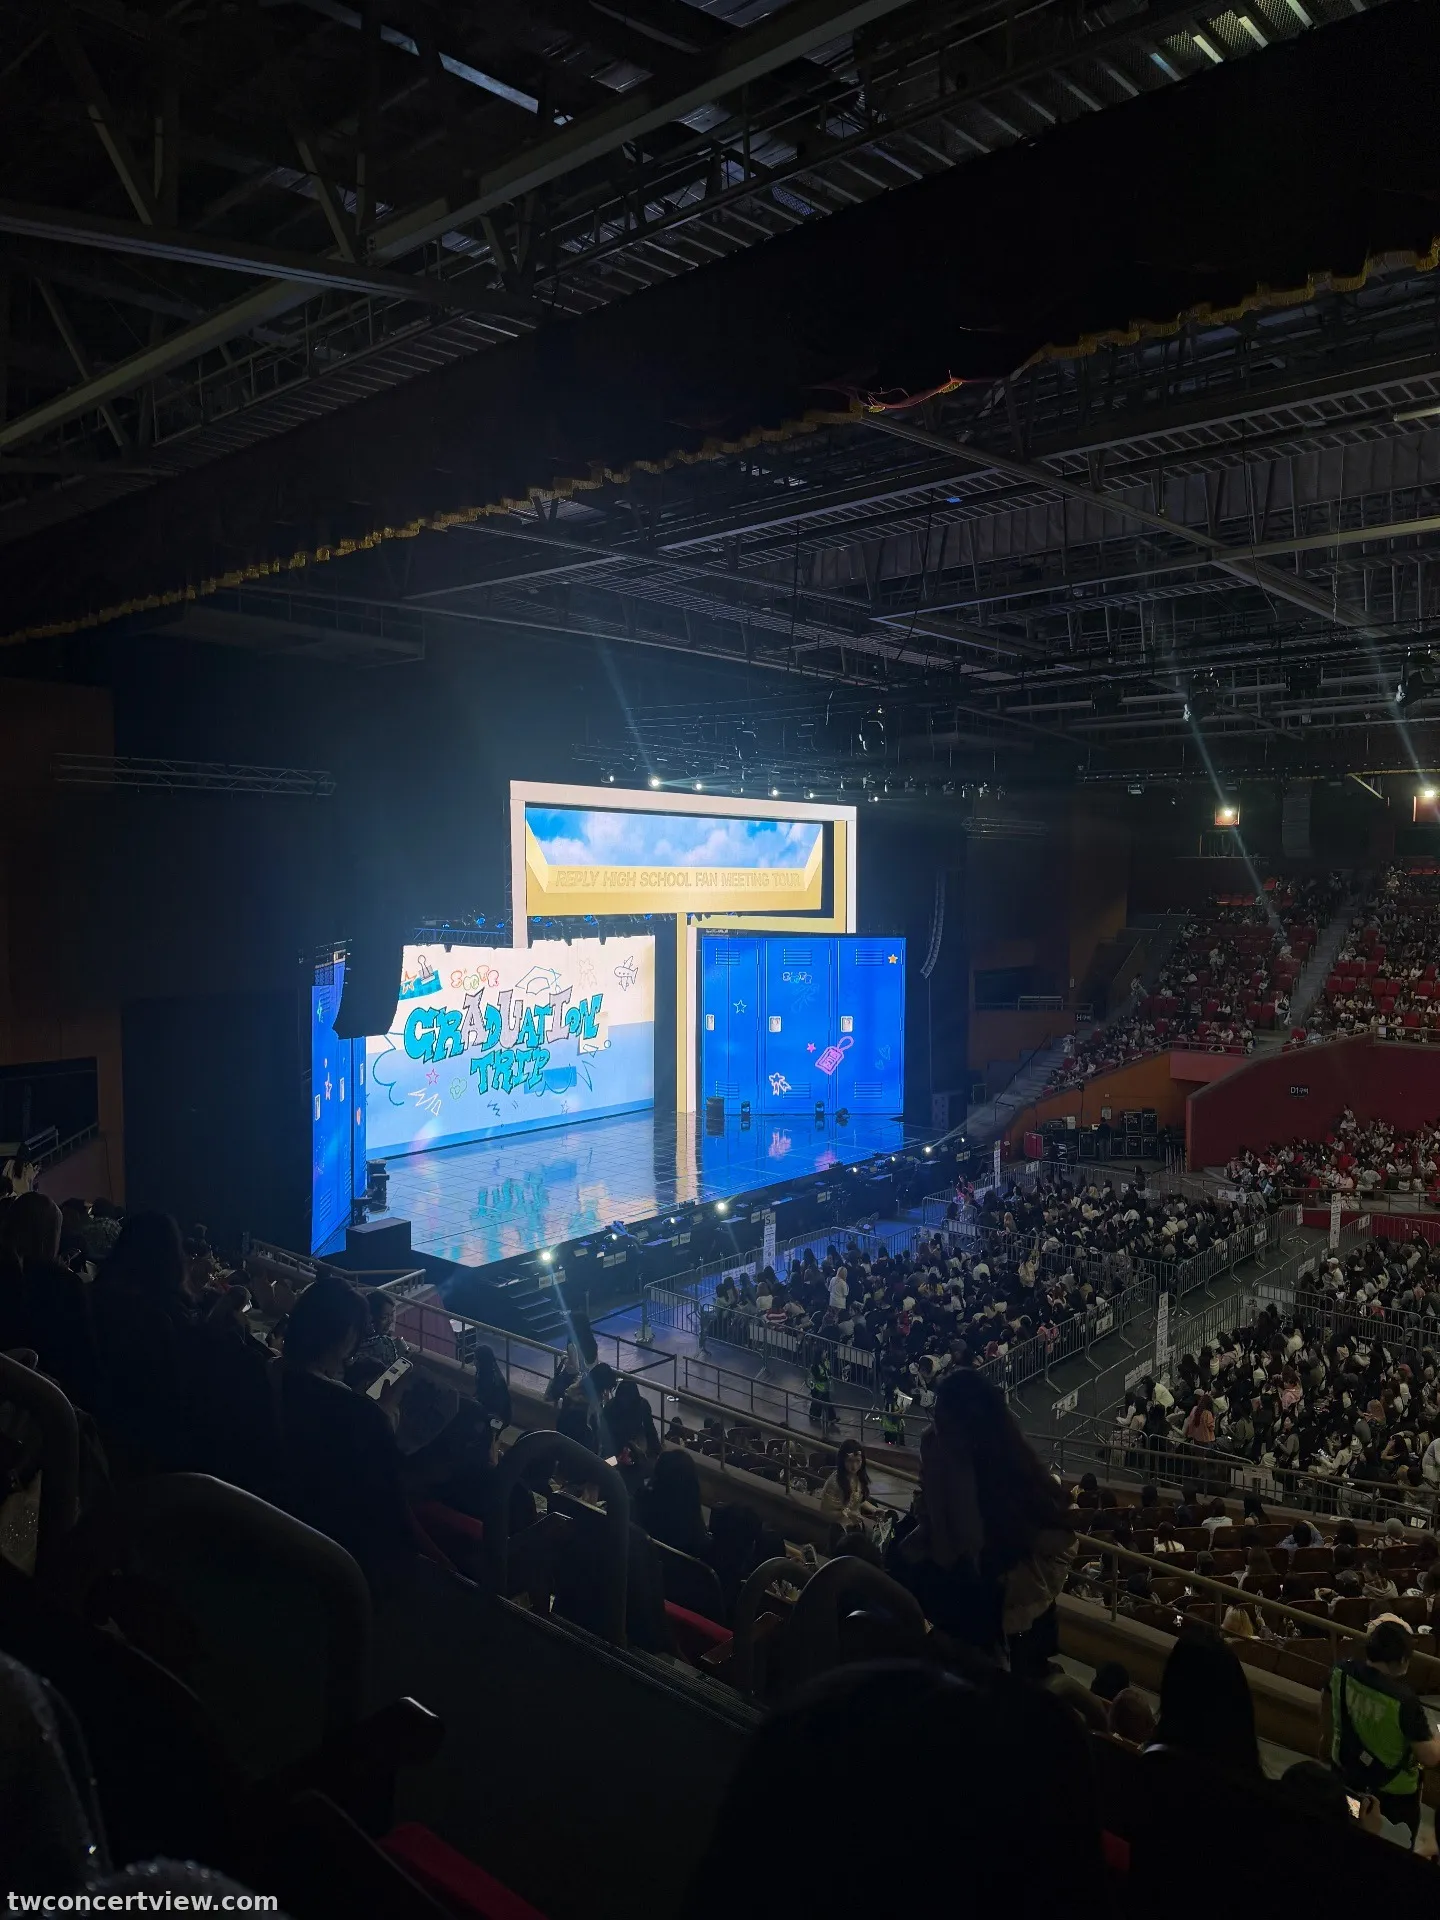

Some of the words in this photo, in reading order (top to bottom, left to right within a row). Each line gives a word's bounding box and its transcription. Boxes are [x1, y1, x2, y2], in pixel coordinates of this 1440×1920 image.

[555, 870, 600, 887] REPLY
[602, 871, 637, 887] HIGH
[640, 871, 692, 887] SCHOOL
[695, 872, 718, 887] FAN
[721, 872, 770, 888] MEETING
[772, 872, 801, 887] TOUR
[403, 985, 604, 1063] GRADUATION
[469, 1048, 551, 1096] TRIP
